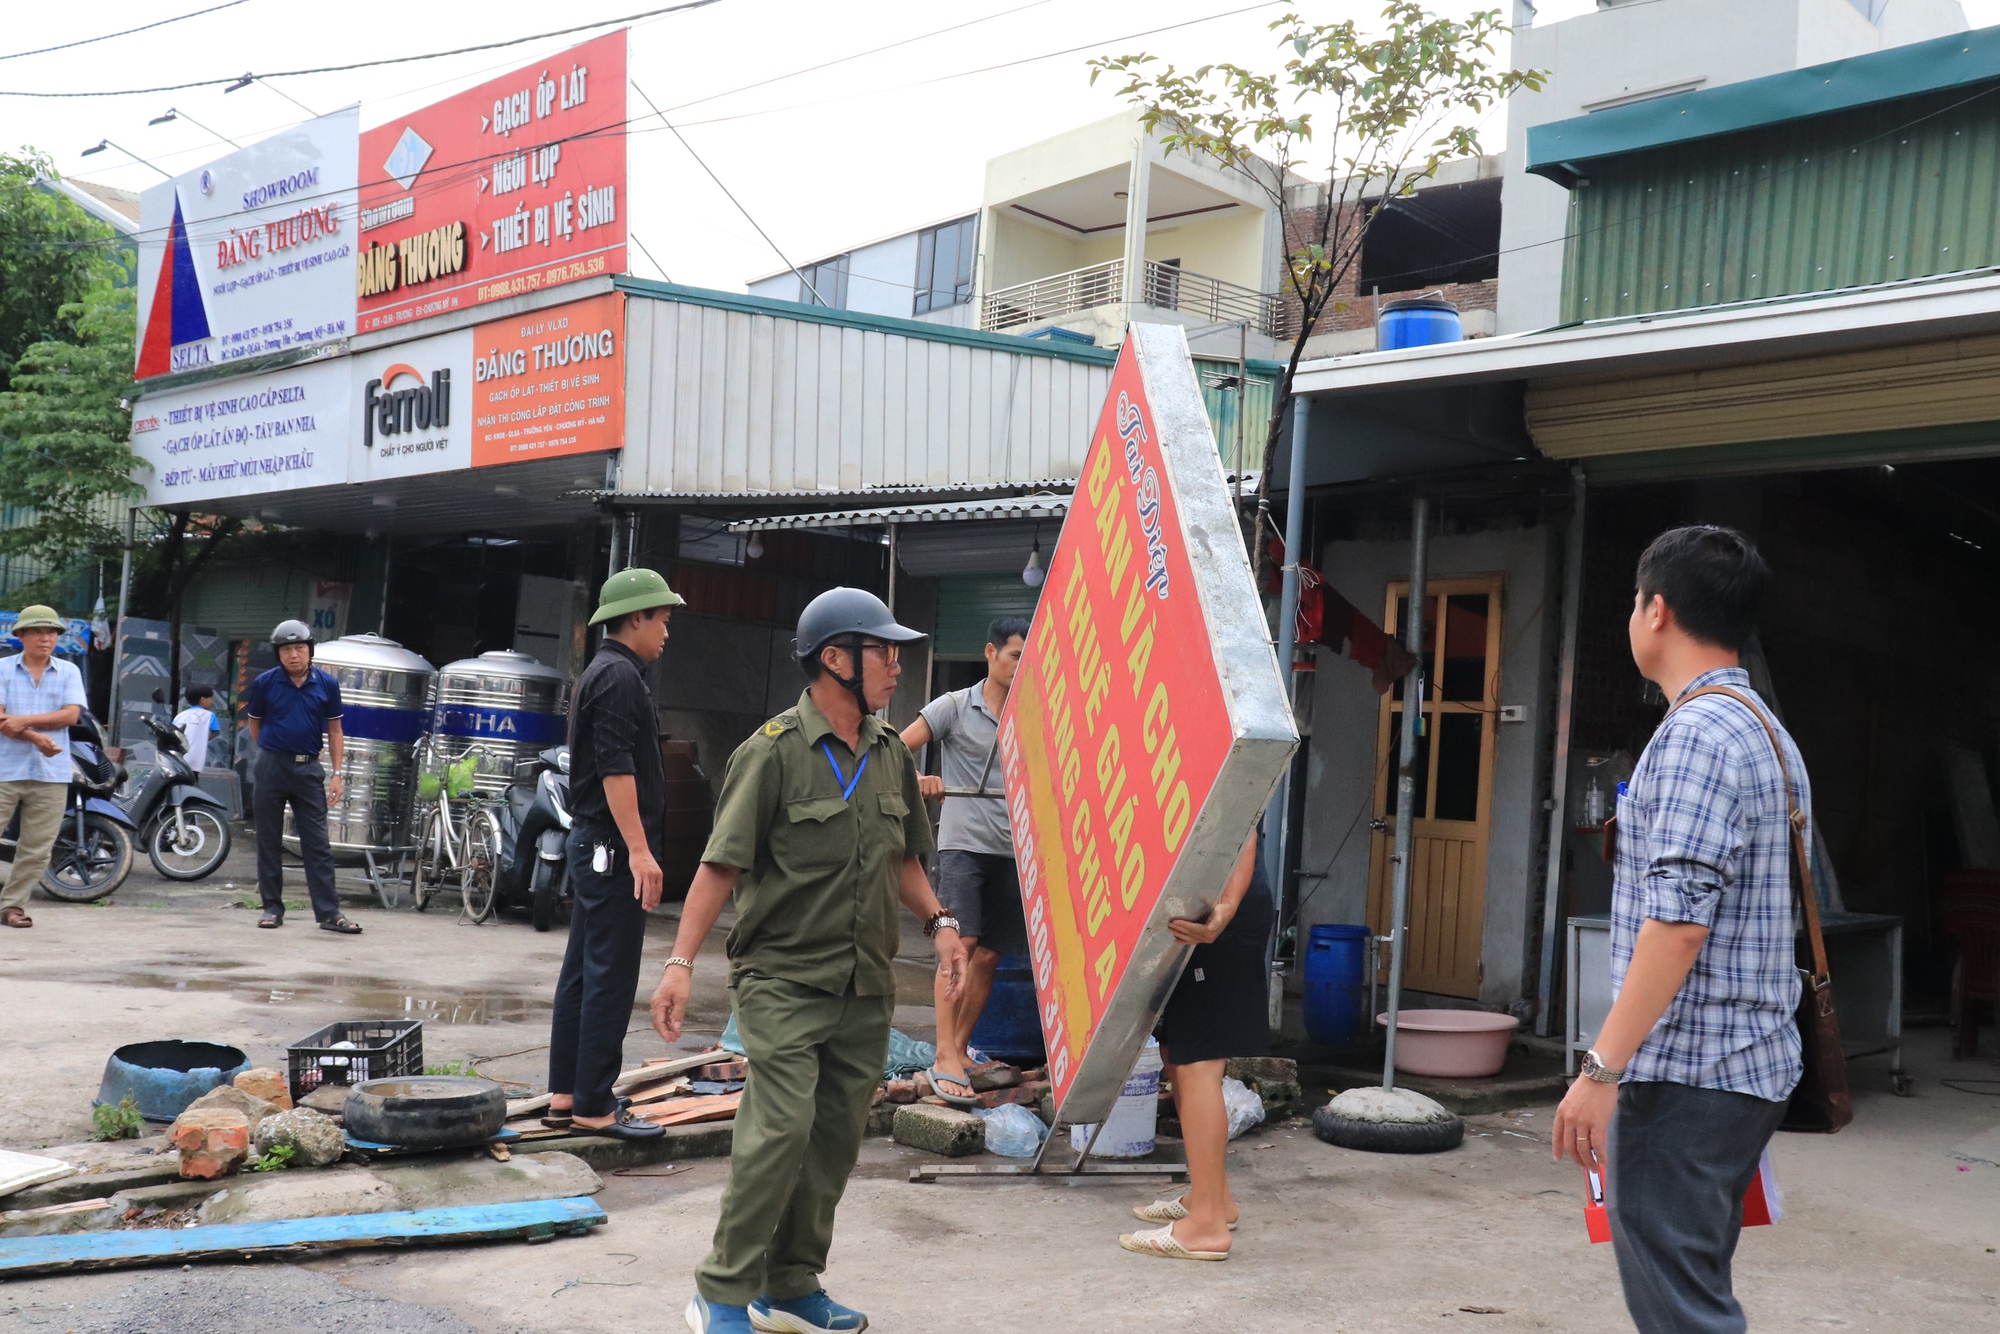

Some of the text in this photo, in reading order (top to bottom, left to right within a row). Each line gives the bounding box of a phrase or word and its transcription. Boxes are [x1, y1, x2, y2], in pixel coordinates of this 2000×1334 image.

[493, 63, 588, 138] GẠCH ỐP LÁT
[243, 166, 319, 210] SHOWROOM
[493, 141, 560, 196] NGÓI LỢP
[217, 202, 338, 269] ĐĂNG THƯƠNG
[492, 200, 532, 254] THIẾT
[534, 204, 550, 247] BỊ
[553, 190, 574, 241] VỆ
[323, 248, 337, 262] CAO
[358, 220, 464, 297] ĐĂNG THƯƠNG
[546, 256, 605, 284] 0976.754.536
[536, 320, 545, 334] LÝ
[547, 317, 569, 331] VLXD
[172, 343, 210, 371] SELTA
[475, 329, 613, 383] ĐĂNG THƯƠNG
[168, 385, 305, 425] THIẾT BỊ VỆ SINH CAO CẤP SELTA
[477, 394, 610, 428] NHẬN THI CÔNG LẮP ĐẶT CÔNG TRÌNH
[489, 373, 600, 403] GẠCH ỐP LÁT THIẾT BỊ VỆ SINH
[166, 436, 189, 455] GẠCH
[204, 427, 221, 447] LÁT
[236, 425, 248, 446] ĐỘ
[275, 418, 294, 434] BAN
[296, 415, 316, 432] NHA
[380, 443, 395, 458] CHẤT
[402, 444, 414, 454] CHO
[416, 438, 434, 453] NGƯỜI
[436, 437, 449, 451] VIỆT
[165, 467, 179, 486] BẾP
[259, 453, 284, 475] NHẬP
[1117, 389, 1171, 600] Tài Diệp
[1087, 434, 1191, 853] BÁN VÀ CHO
[1064, 546, 1145, 911] THUÊ GIÁO
[1037, 600, 1118, 1003] THANG CHỮ A
[1001, 714, 1069, 1089] ĐT: 0989 806 316
